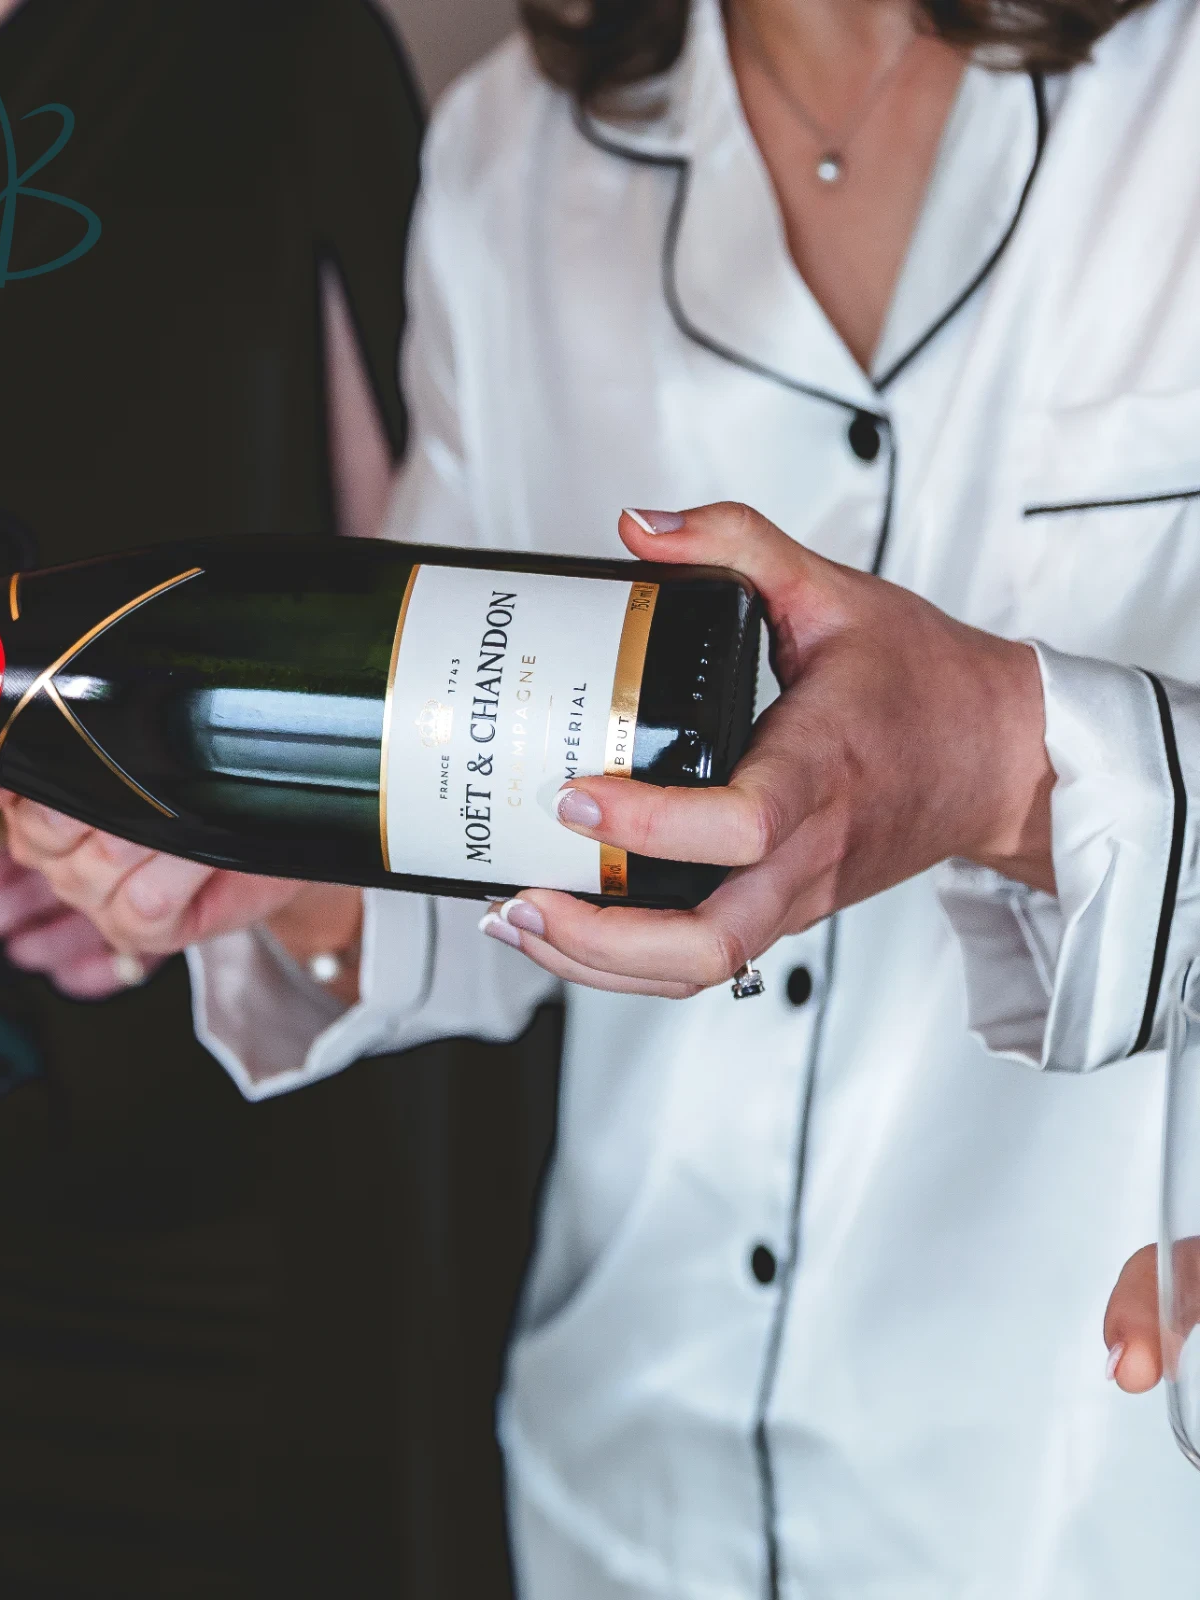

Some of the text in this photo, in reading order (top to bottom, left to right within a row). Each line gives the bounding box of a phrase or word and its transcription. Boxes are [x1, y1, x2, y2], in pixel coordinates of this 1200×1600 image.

[447, 658, 460, 694] 1743
[460, 591, 518, 864] MOËT & CHANDON
[507, 655, 536, 807] CHAMPAGNE
[564, 682, 587, 780] MPÉRIAL
[614, 716, 629, 766] BRUT
[439, 754, 450, 800] FRANCE
